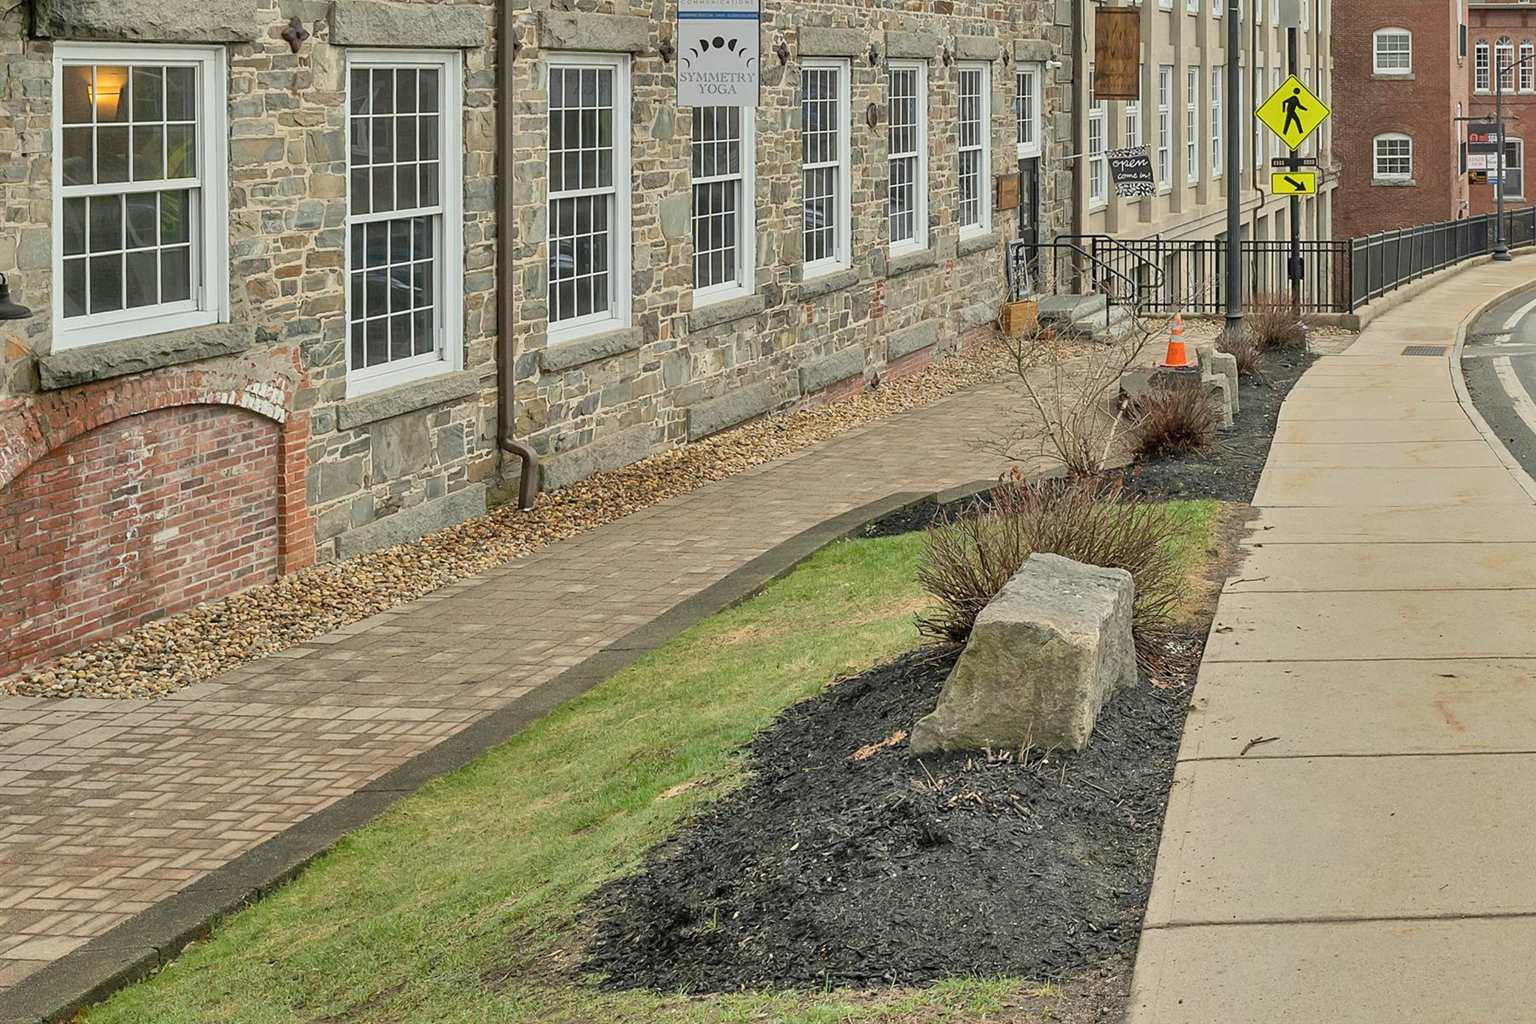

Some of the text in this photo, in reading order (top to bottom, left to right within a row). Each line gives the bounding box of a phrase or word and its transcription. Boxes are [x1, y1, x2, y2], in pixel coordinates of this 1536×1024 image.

[680, 71, 756, 83] SYMMETRY
[699, 83, 737, 95] YOGA
[1112, 158, 1149, 172] open
